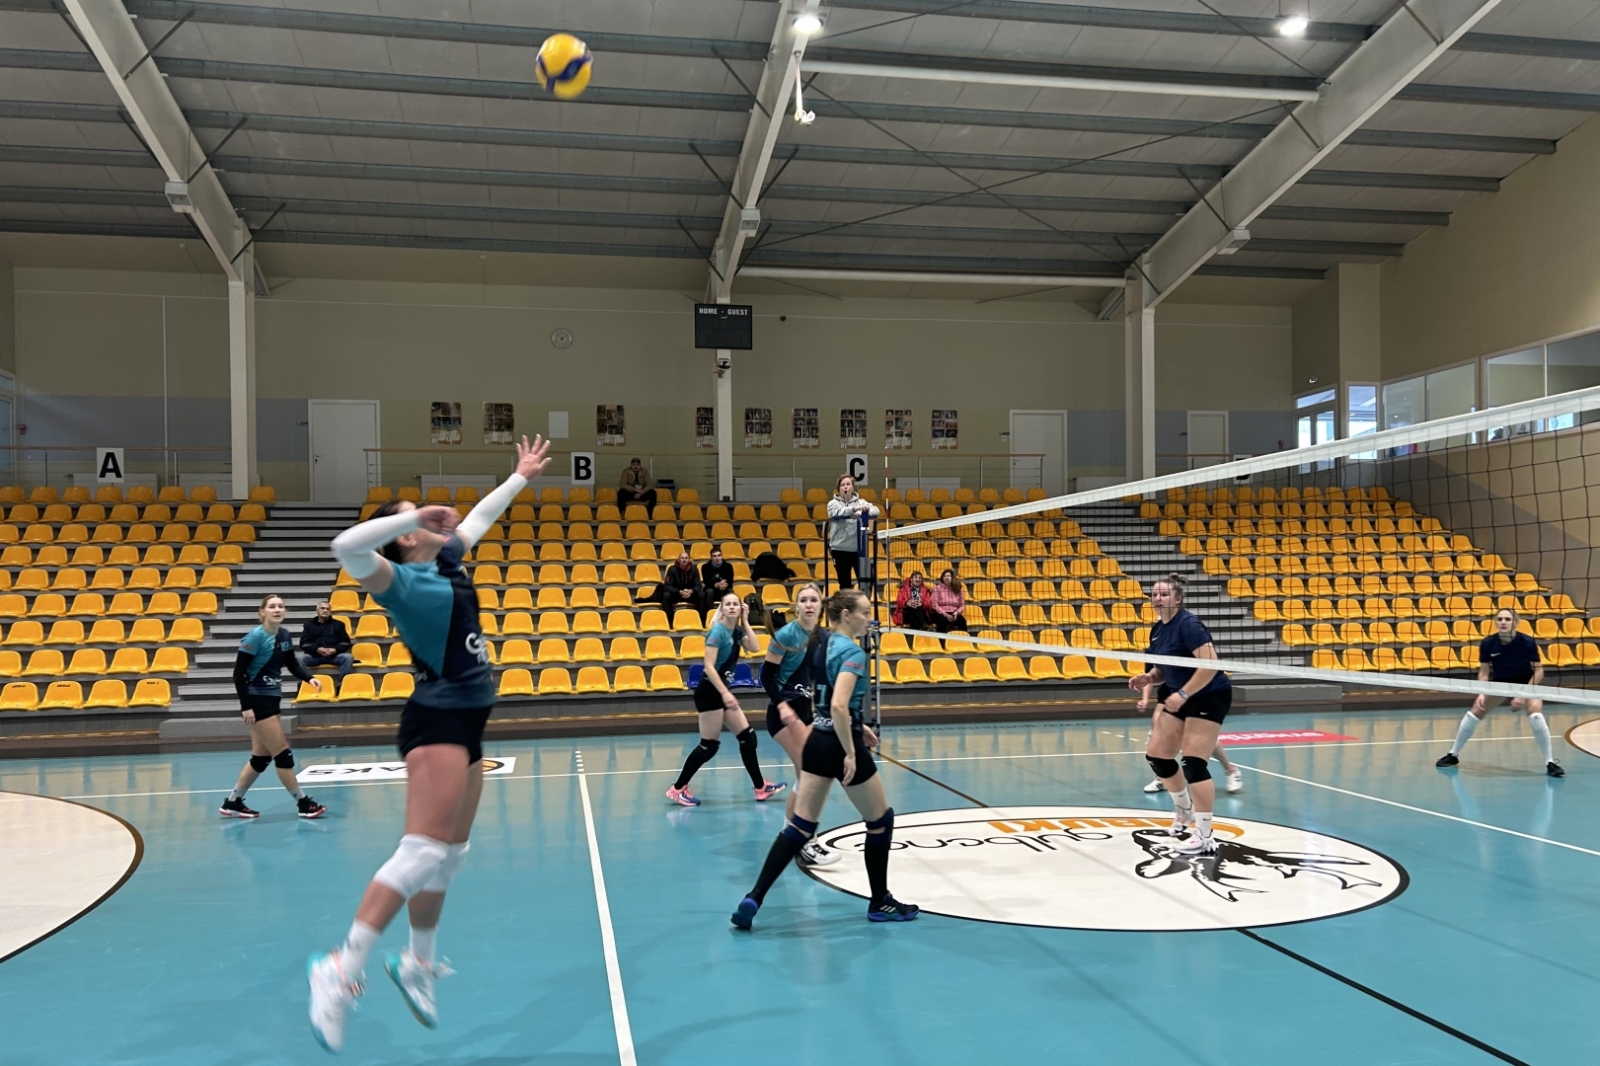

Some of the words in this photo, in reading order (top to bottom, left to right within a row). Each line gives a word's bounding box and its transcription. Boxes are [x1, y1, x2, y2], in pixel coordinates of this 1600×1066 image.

[699, 307, 718, 315] HOME
[727, 308, 748, 316] GUEST
[98, 452, 122, 478] A
[574, 456, 592, 480] B
[849, 457, 865, 482] C
